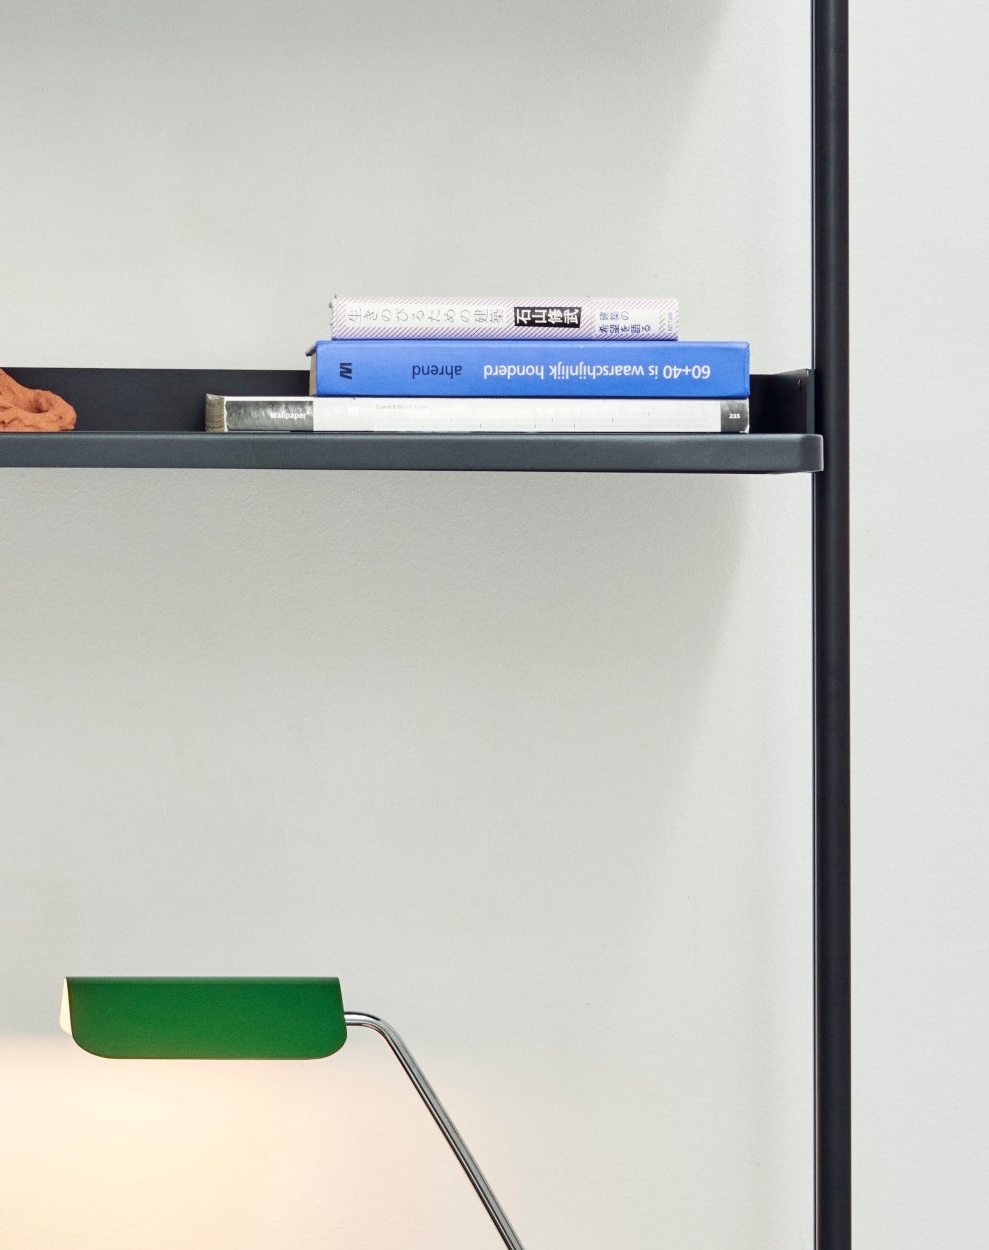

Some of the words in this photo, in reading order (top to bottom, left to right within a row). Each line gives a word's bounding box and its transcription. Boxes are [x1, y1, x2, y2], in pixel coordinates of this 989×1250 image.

[348, 308, 505, 323] 生きのびるための建築
[516, 308, 579, 324] 石山修武
[412, 364, 462, 379] ahrend
[483, 364, 544, 379] honderd
[548, 364, 645, 379] waarschijnlijk
[649, 365, 659, 379] is
[663, 365, 711, 380] 60+40
